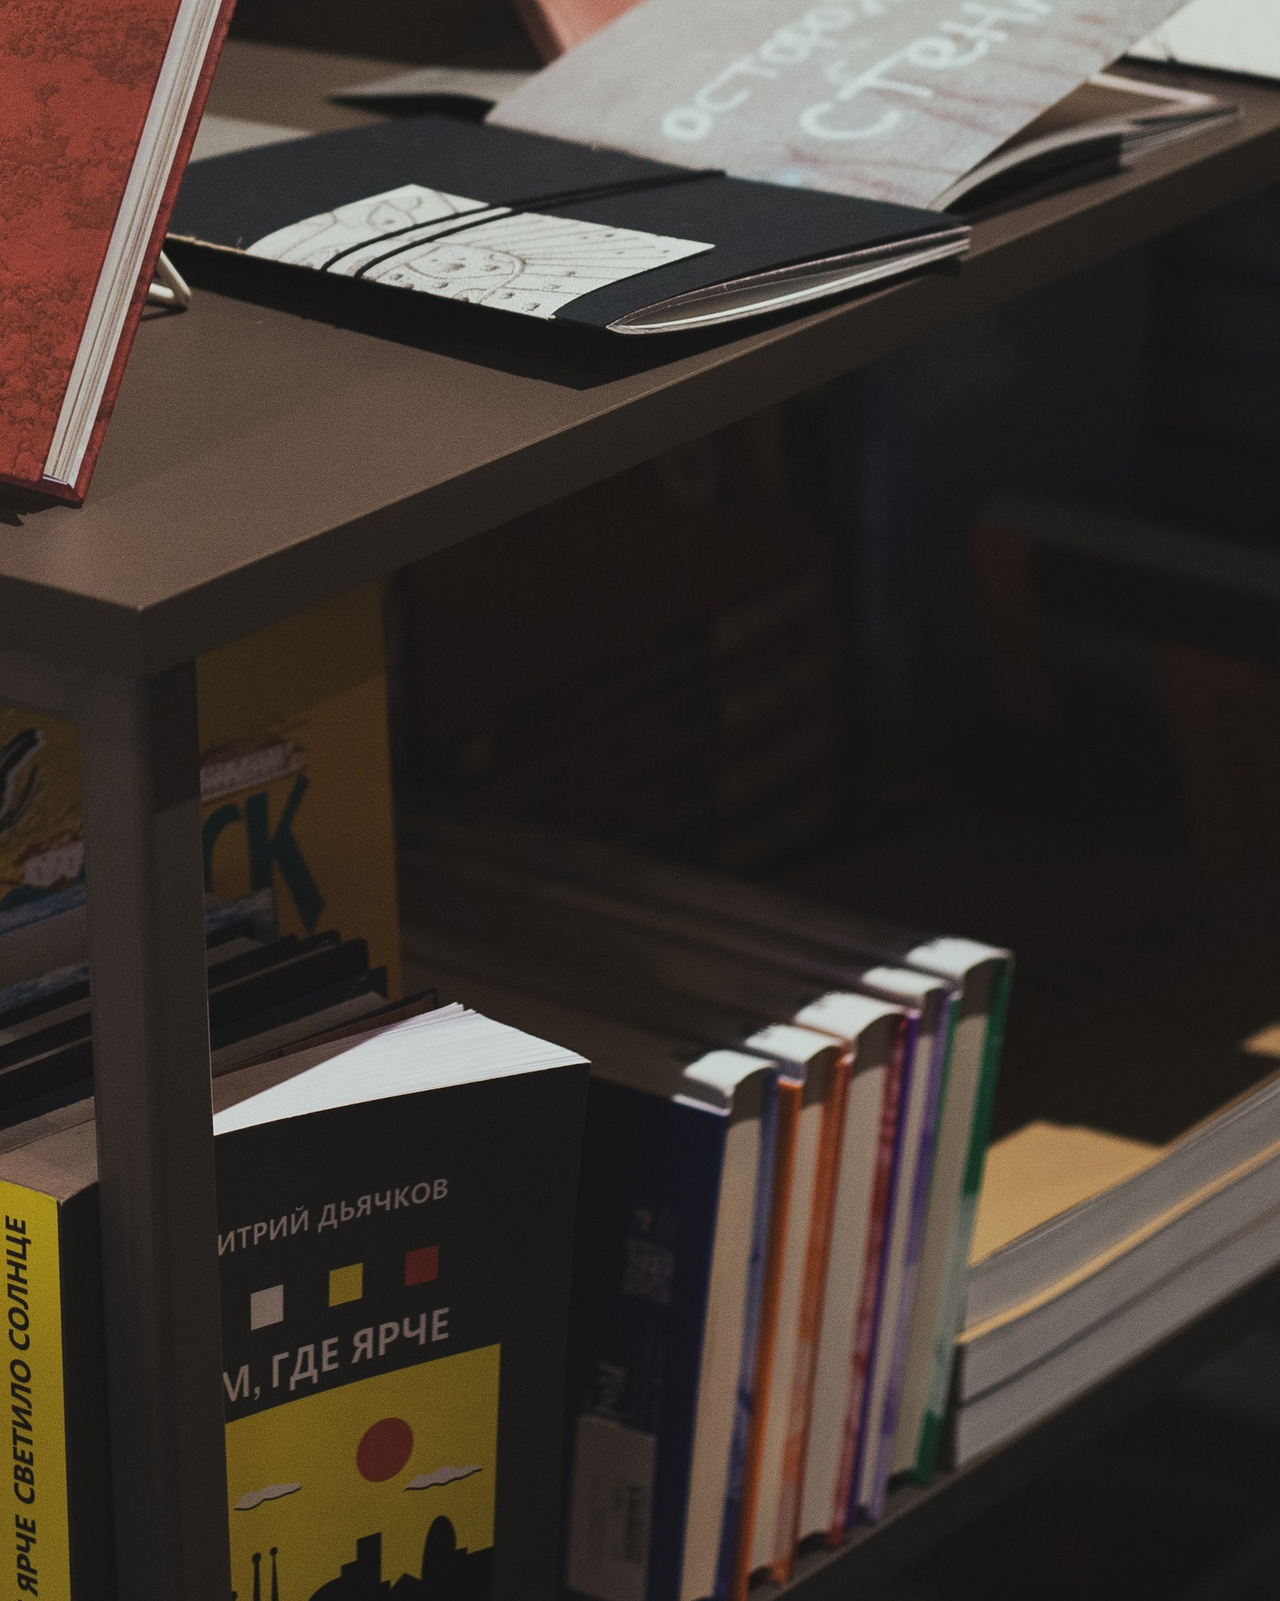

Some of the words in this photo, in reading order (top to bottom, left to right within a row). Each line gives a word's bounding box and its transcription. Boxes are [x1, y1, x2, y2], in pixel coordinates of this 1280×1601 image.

[217, 1204, 310, 1257] ИТРИЙ
[317, 1178, 449, 1234] ДЬЯЧКОВ
[5, 1214, 32, 1351] СОЛНЦЕ
[271, 1336, 340, 1392] ГДЕ
[351, 1306, 450, 1364] ЯРЧЕ
[8, 1358, 36, 1505] СВЕТИЛО
[15, 1513, 39, 1597] ЯРЧЕ
